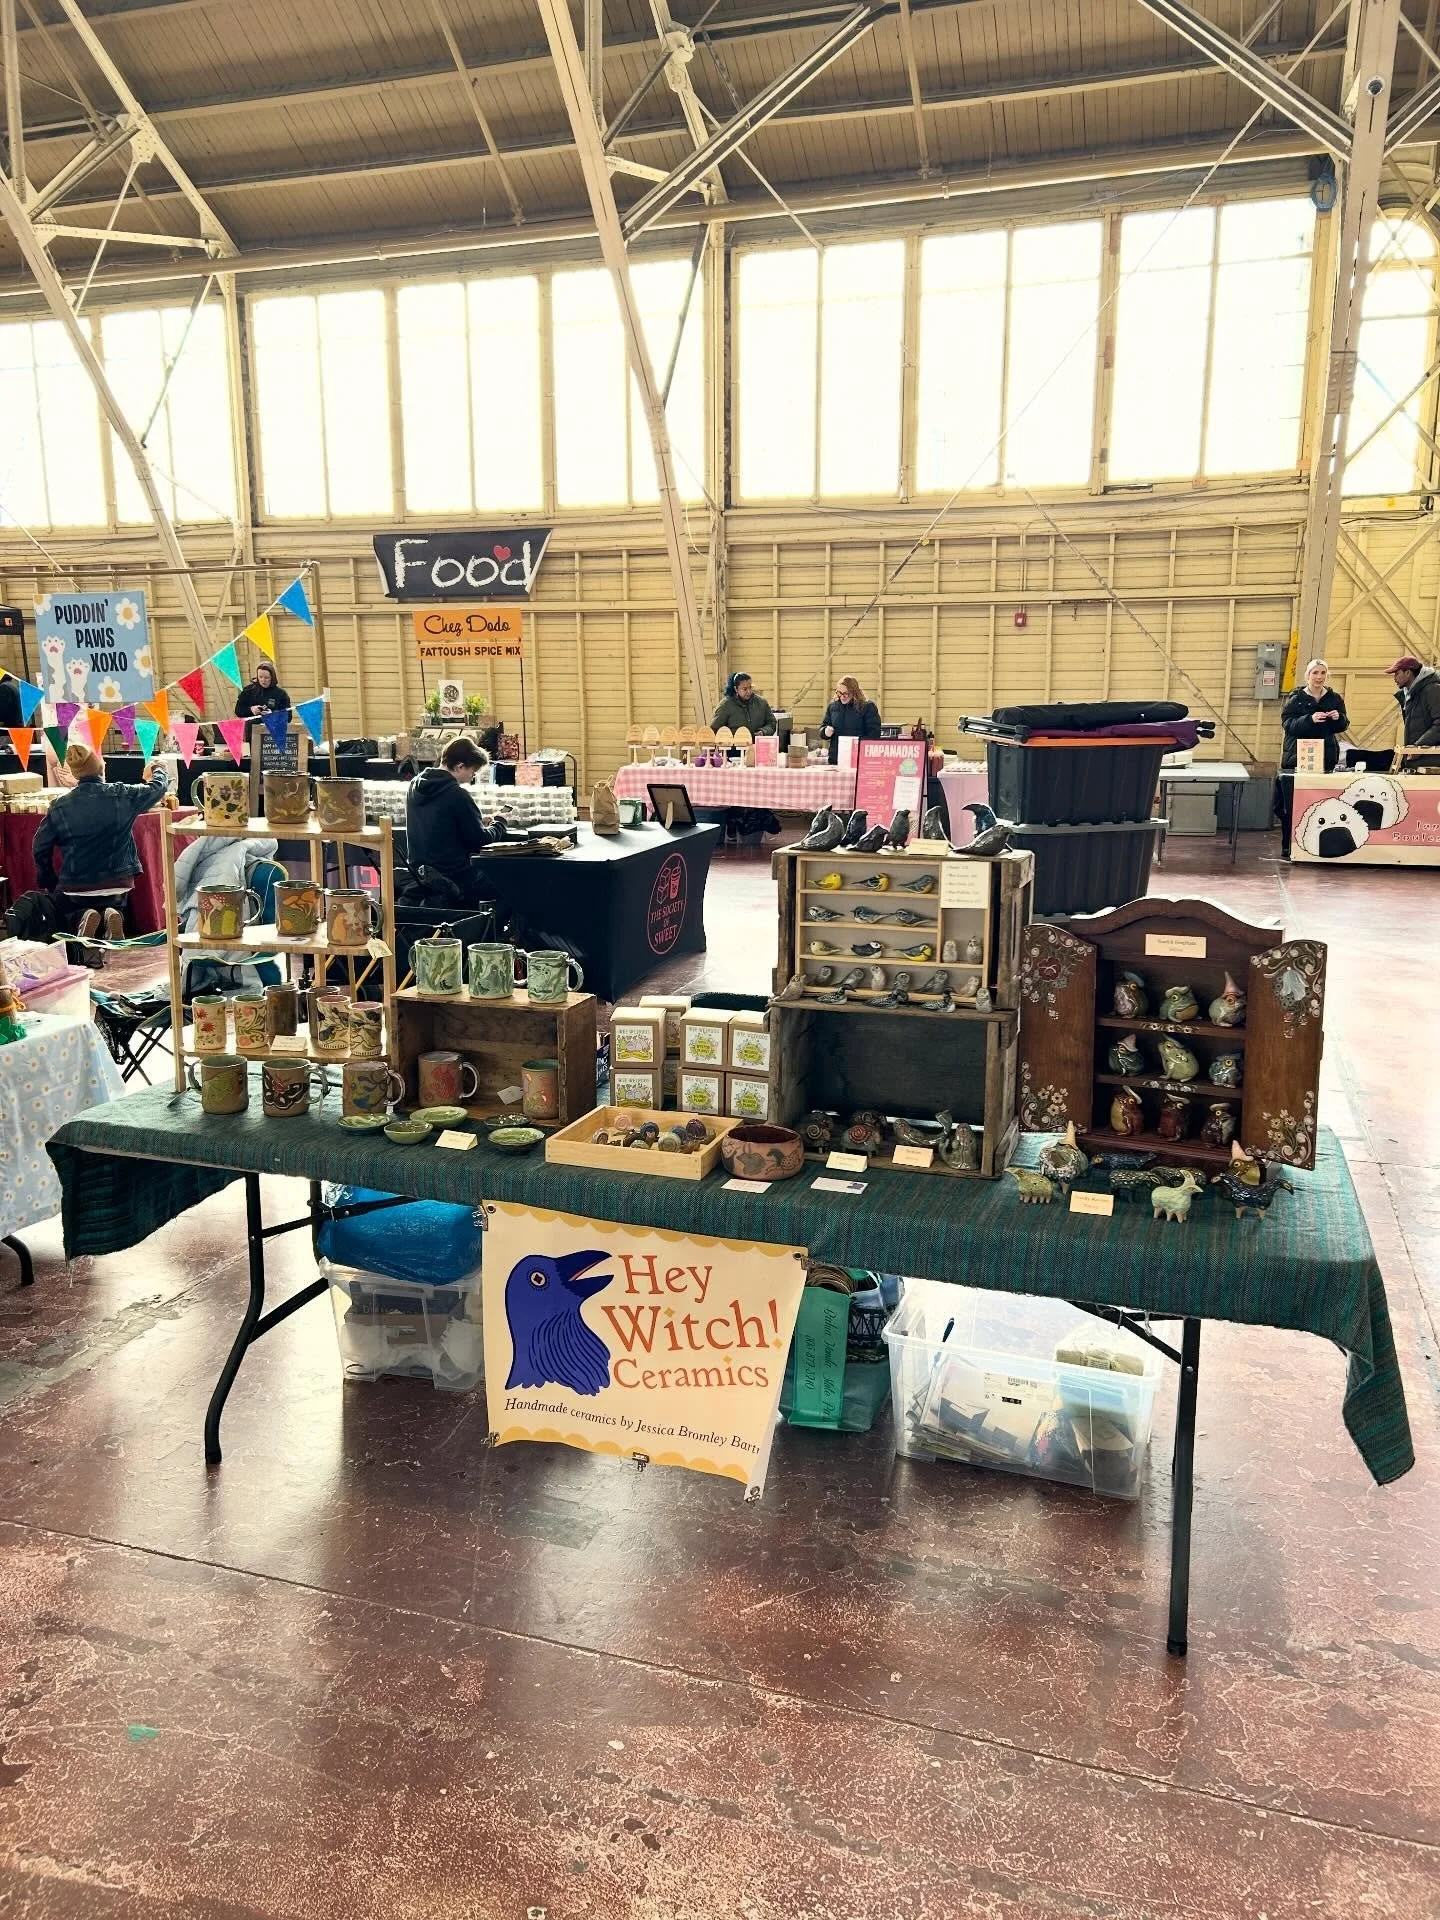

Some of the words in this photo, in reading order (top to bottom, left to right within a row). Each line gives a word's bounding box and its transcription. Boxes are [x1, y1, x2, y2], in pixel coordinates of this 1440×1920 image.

[394, 538, 532, 589] Food
[54, 598, 109, 625] PUDDIN'
[423, 614, 464, 637] Chez
[465, 614, 511, 633] Dodo
[75, 627, 115, 649] PAWS
[90, 651, 128, 673] XOXO
[420, 646, 471, 656] FATTOUSH
[474, 645, 502, 656] SPICE
[505, 645, 521, 656] MIX
[864, 744, 920, 758] EMPANADAS
[650, 911, 662, 924] THE
[661, 900, 684, 918] SOCIETY
[663, 917, 671, 928] OF
[654, 924, 677, 946] SWEET
[618, 1254, 713, 1304] Hey
[600, 1298, 784, 1354] Witch!
[613, 1355, 769, 1390] Ceramics
[504, 1398, 568, 1415] Handmade
[570, 1406, 617, 1426] ceramics
[620, 1415, 634, 1430] by
[634, 1419, 675, 1437] Jessica
[678, 1425, 728, 1447] Bromley
